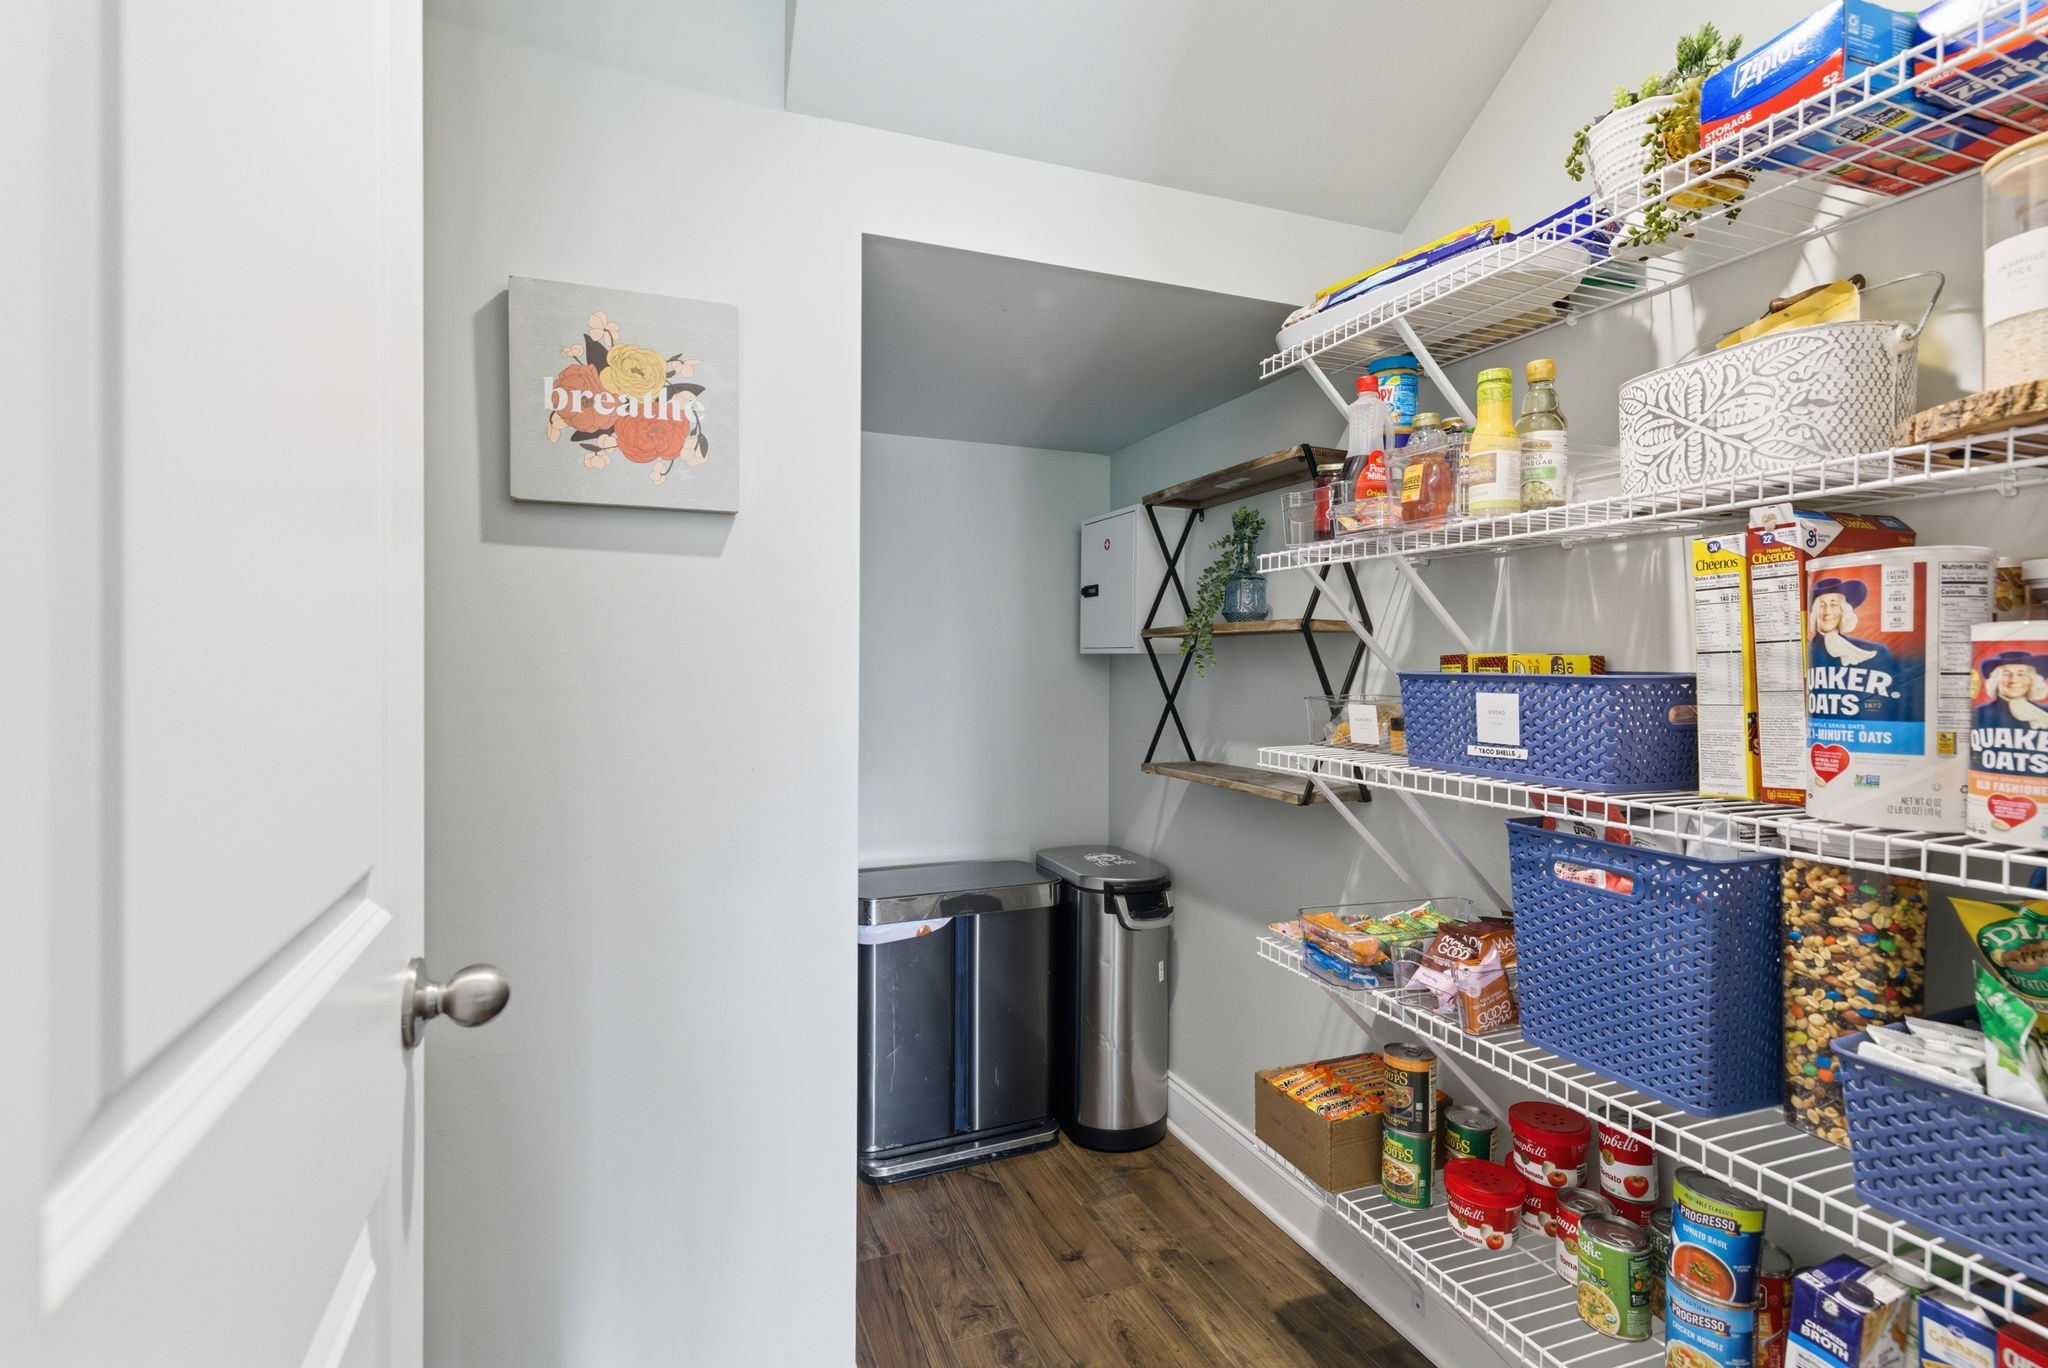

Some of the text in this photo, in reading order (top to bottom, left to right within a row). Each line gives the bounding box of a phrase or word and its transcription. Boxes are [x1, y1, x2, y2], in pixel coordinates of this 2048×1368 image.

[1821, 71, 1840, 88] 52
[1704, 110, 1753, 143] STORAGE
[543, 376, 705, 423] breathe
[1696, 558, 1739, 572] Cheerios
[1752, 551, 1796, 565] Cheerios
[1807, 666, 1893, 698] UAKER
[1808, 693, 1860, 716] OATS
[1858, 730, 1893, 745] OATS
[1971, 727, 2048, 753] QUAKE
[1478, 747, 1516, 758] TACO SHELLS
[1981, 749, 2048, 774] OATS
[1993, 780, 2048, 799] FASHIONE
[1437, 942, 1471, 960] GOOD
[1476, 999, 1511, 1025] GOOD
[1680, 1204, 1736, 1232] PROGRESSO
[1708, 1204, 1734, 1218] CLASSICS
[1462, 1231, 1483, 1244] Tomato
[1682, 1223, 1728, 1251] TOMATO BASIL
[1560, 1253, 1578, 1272] Toma
[1671, 1302, 1726, 1333] PROGRESSO
[1672, 1320, 1724, 1353] CHICKEN NOODLE
[1800, 1323, 1850, 1363] BROTH
[1804, 1318, 1848, 1351] CHICKEN
[1928, 1329, 1990, 1366] Graham
